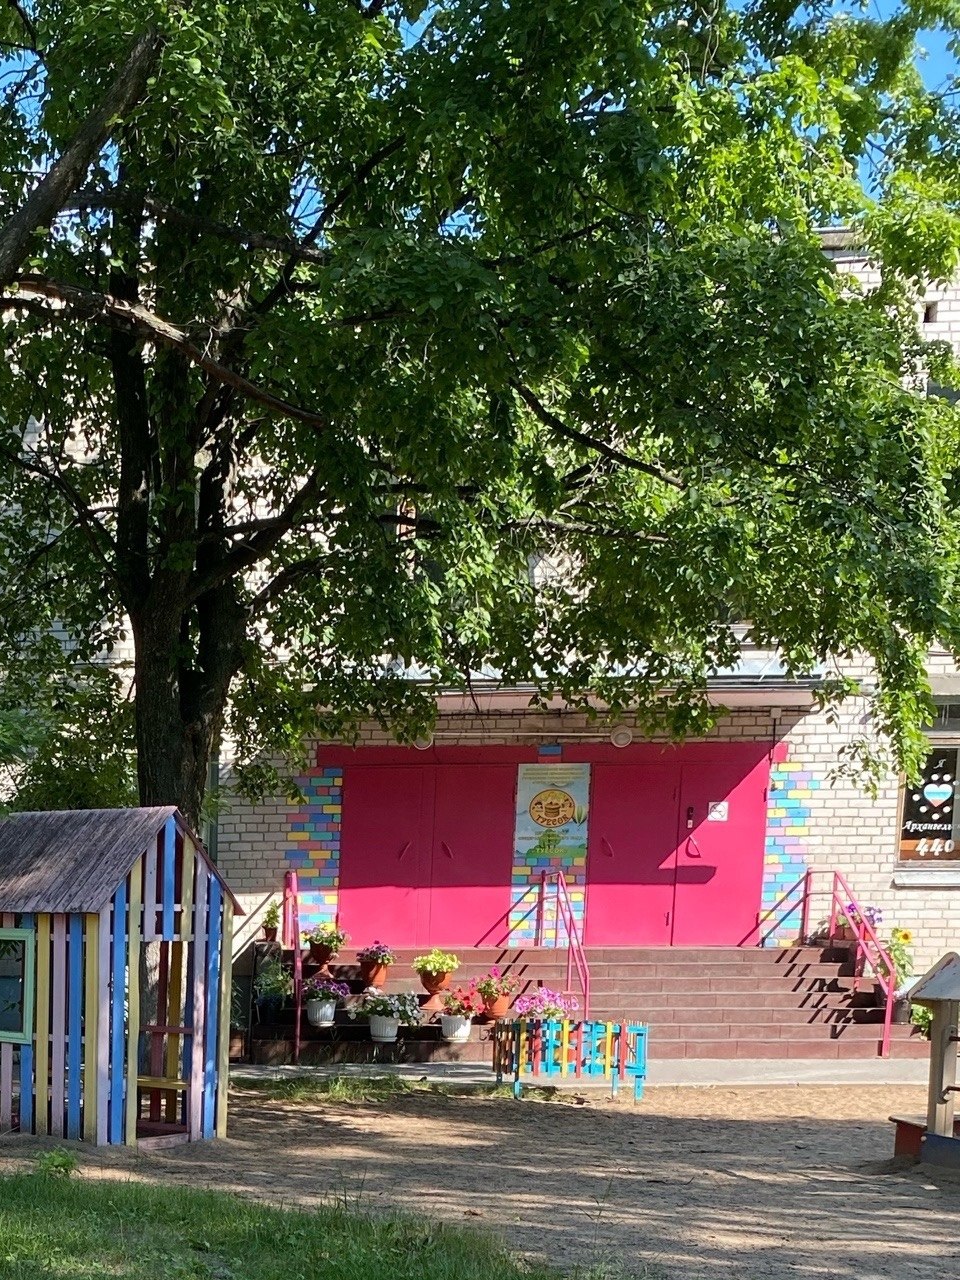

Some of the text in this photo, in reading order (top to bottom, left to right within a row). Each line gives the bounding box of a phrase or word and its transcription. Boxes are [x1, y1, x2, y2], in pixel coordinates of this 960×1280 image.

[933, 759, 946, 769] Я
[536, 814, 569, 826] ТУЕСОК
[915, 838, 955, 856] 440
